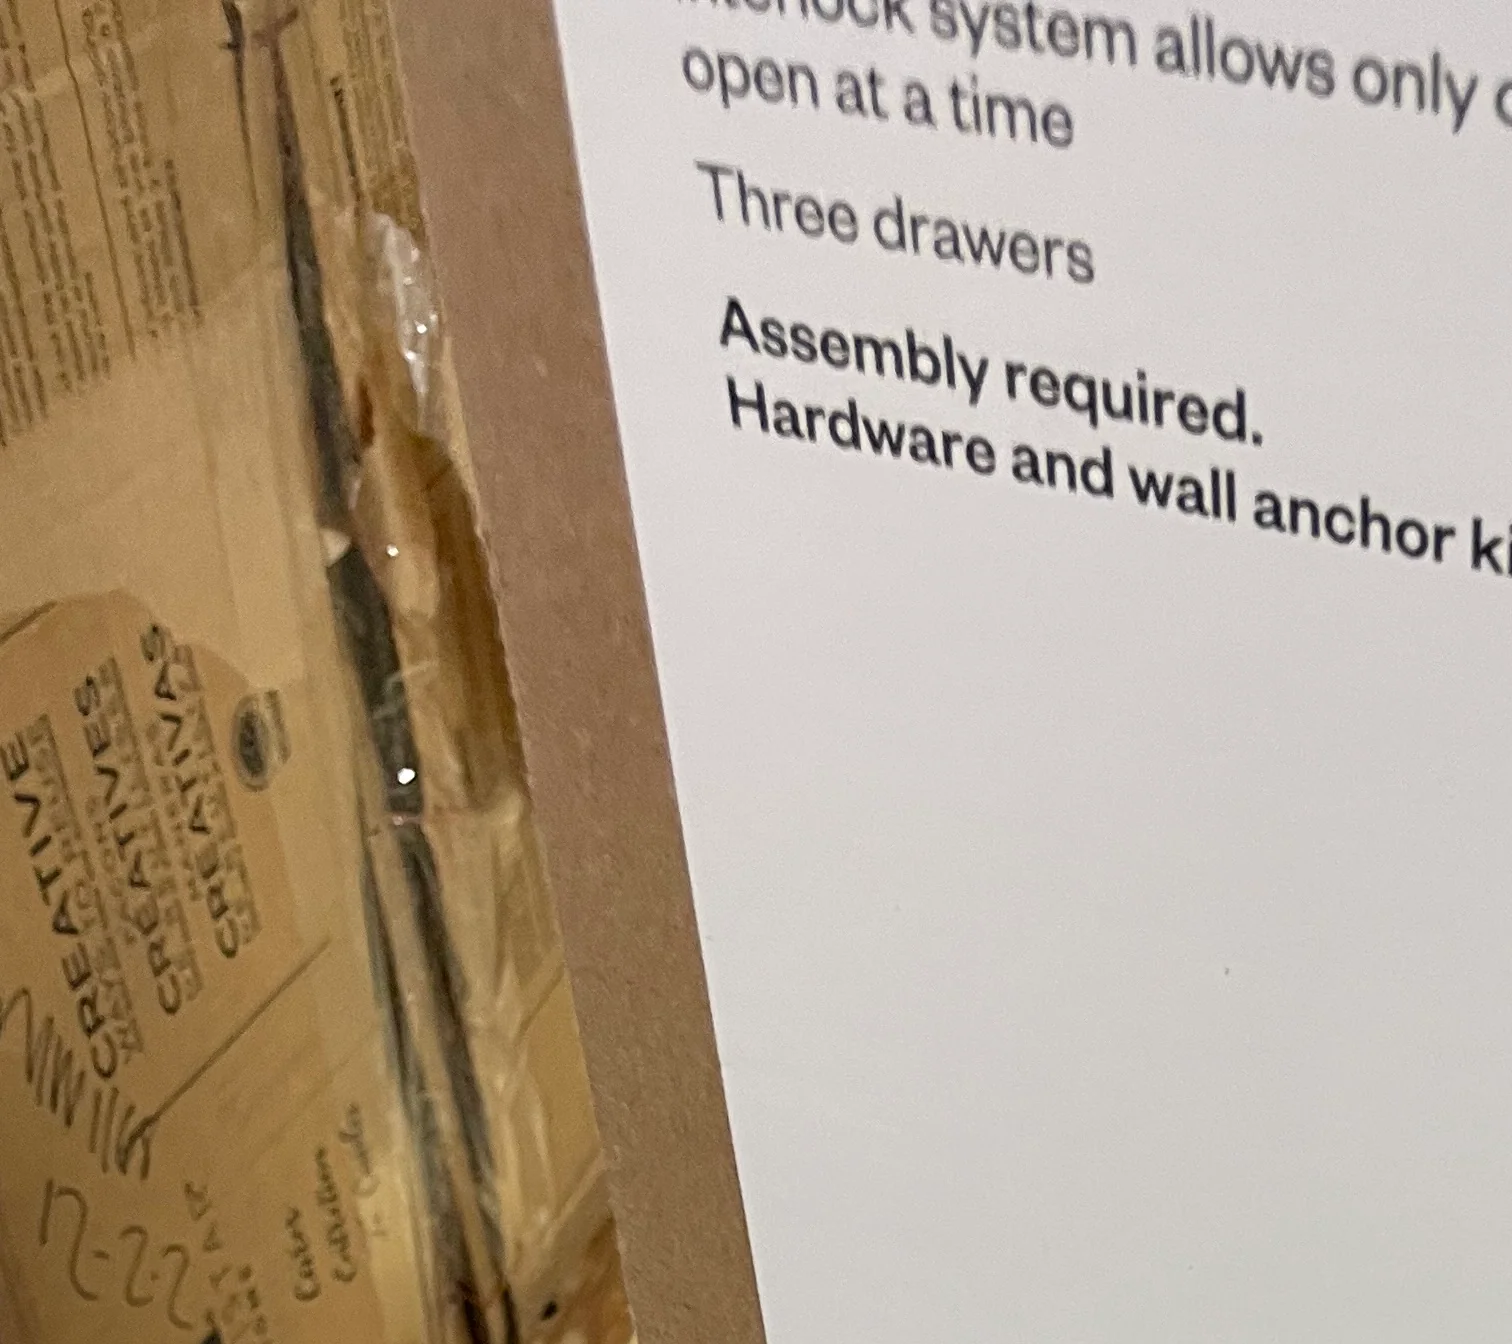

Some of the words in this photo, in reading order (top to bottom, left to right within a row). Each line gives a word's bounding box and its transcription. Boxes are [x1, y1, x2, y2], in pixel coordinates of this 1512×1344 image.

[681, 46, 820, 110] open
[835, 66, 889, 120] at
[902, 79, 939, 128] a
[950, 75, 1075, 150] time
[928, 0, 1138, 66] system
[1154, 13, 1336, 99] allows
[1351, 51, 1480, 135] only
[695, 160, 859, 245] Three
[872, 194, 1095, 285] drawers
[719, 295, 990, 408] Assembly
[1004, 360, 1264, 448] required.
[725, 373, 997, 477] Hardware
[1011, 443, 1115, 501] and
[1127, 464, 1237, 525] wall
[1252, 489, 1457, 565] anchor
